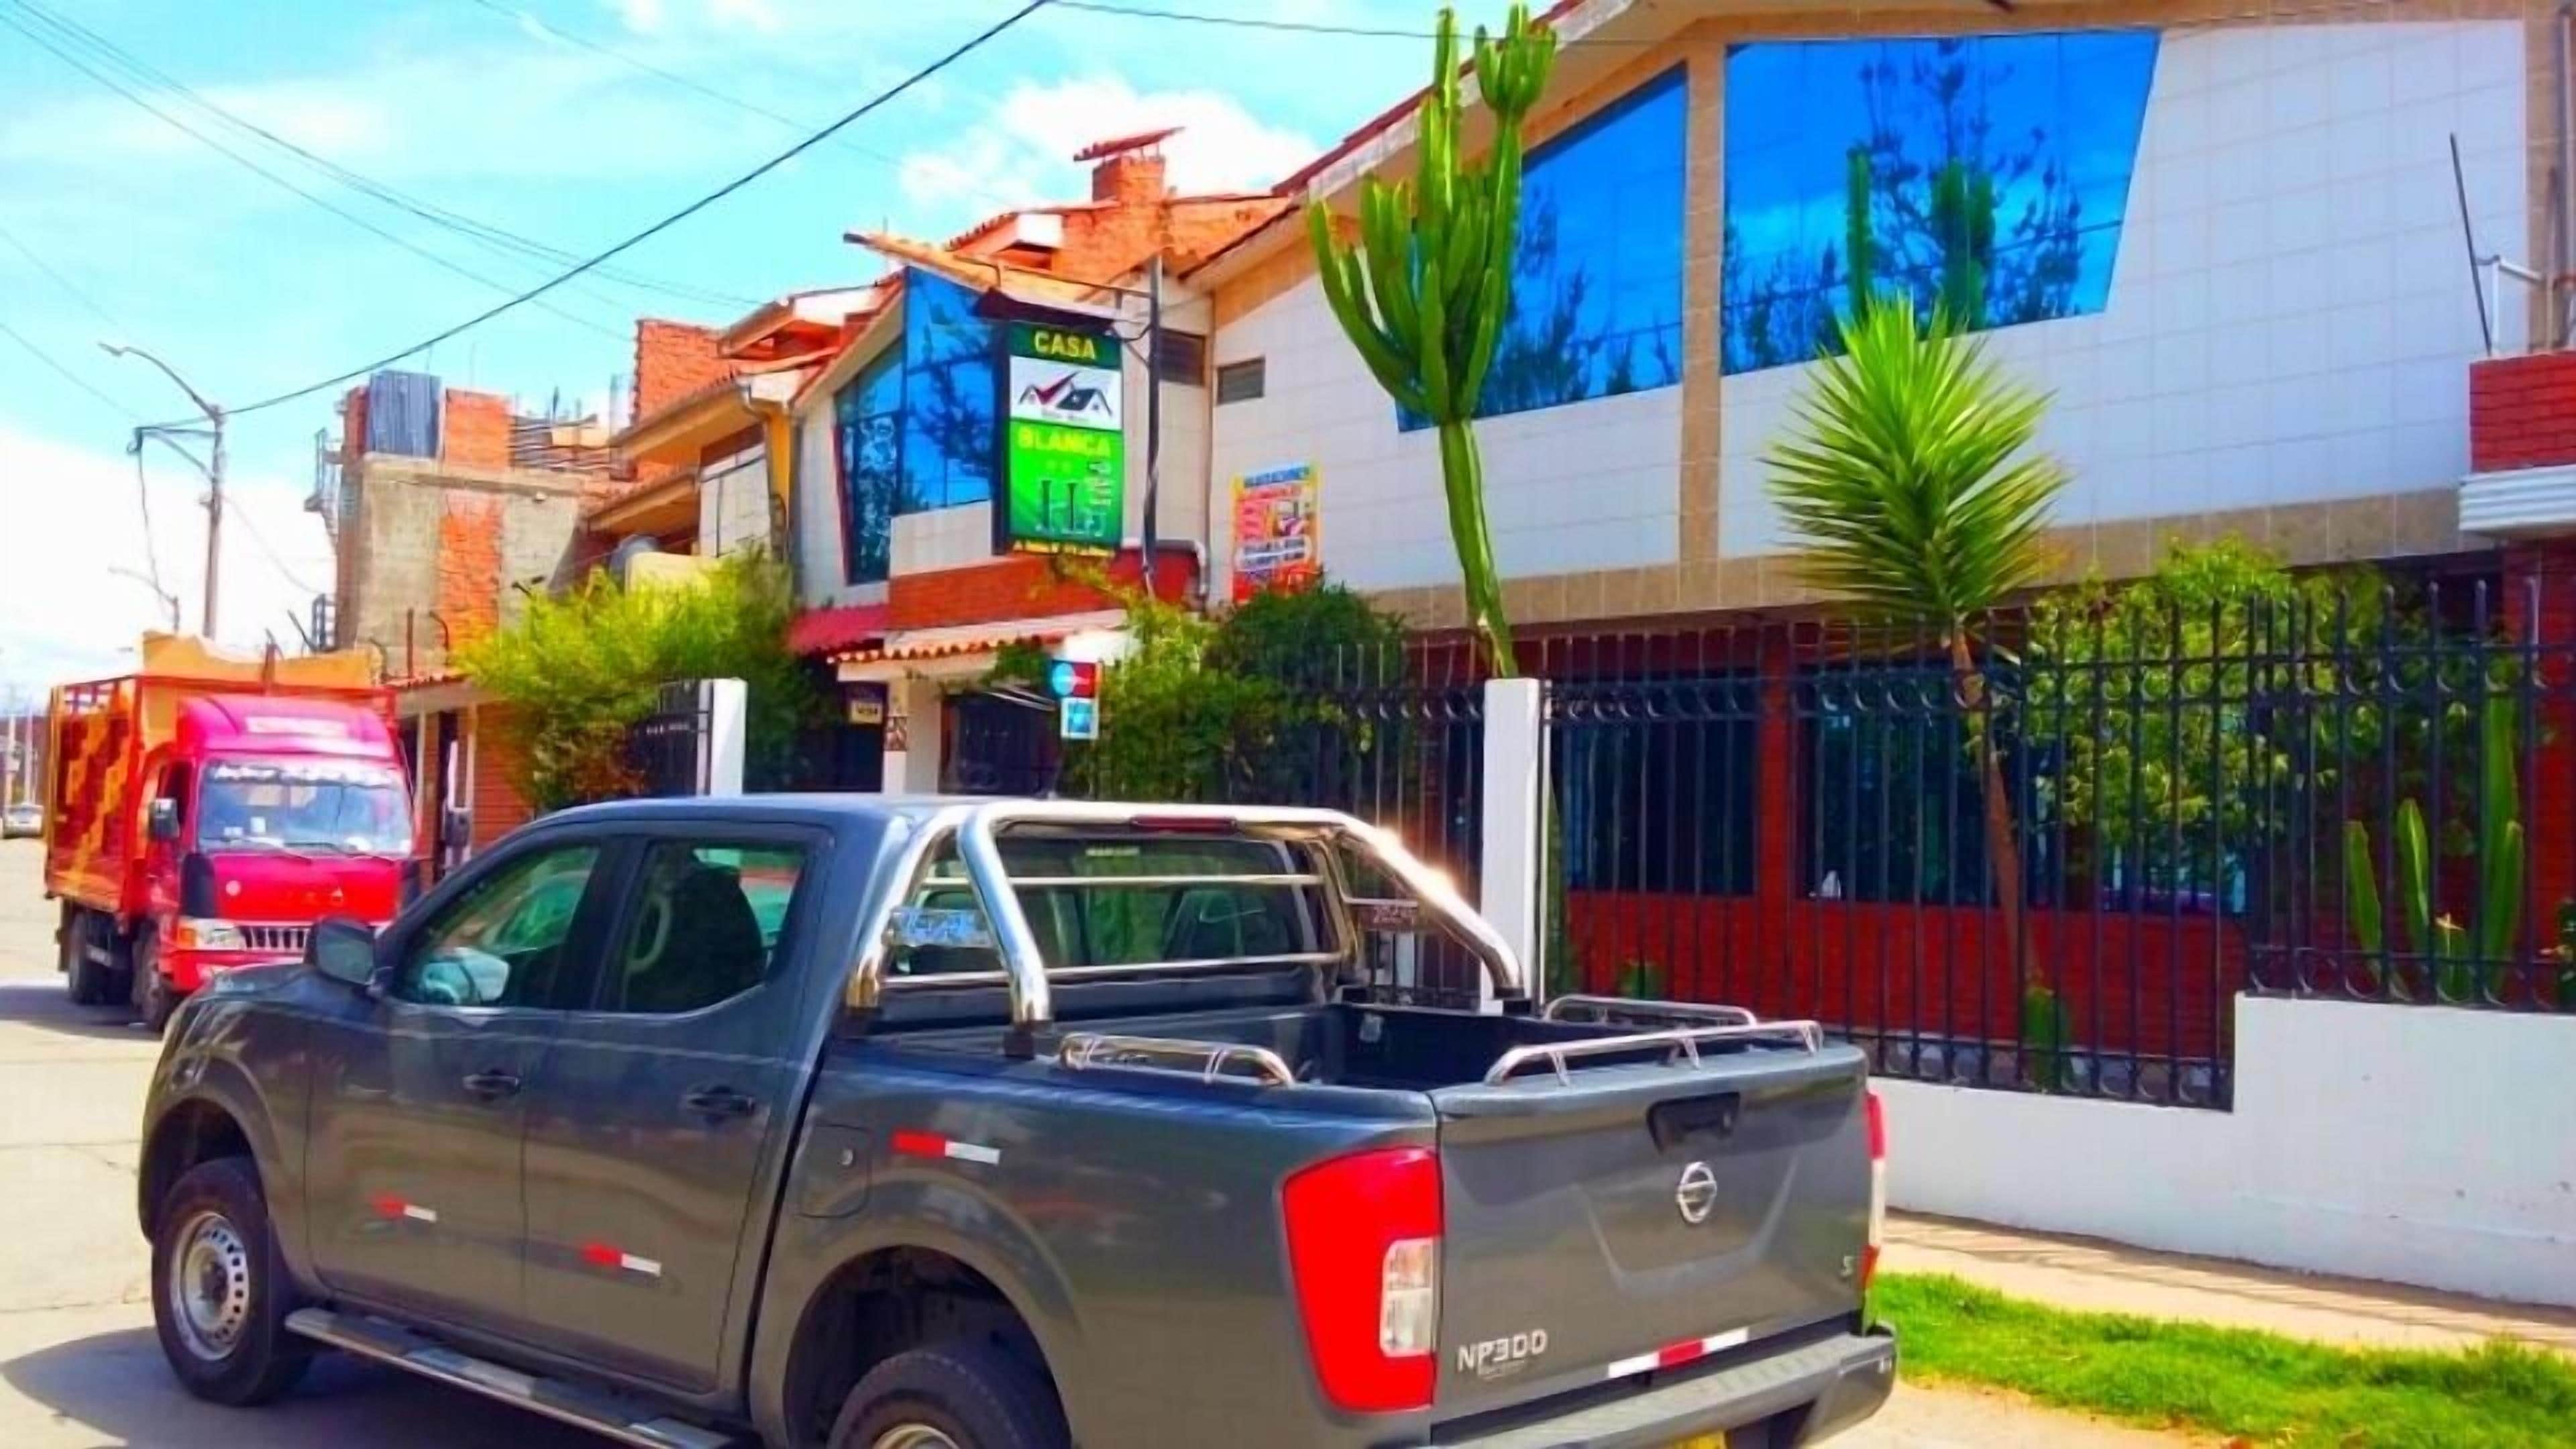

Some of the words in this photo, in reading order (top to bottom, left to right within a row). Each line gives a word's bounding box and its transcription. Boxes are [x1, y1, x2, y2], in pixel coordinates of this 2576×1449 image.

[1034, 331, 1096, 360] CASA
[1018, 425, 1112, 456] BLANCA
[1458, 1328, 1548, 1372] NP300
